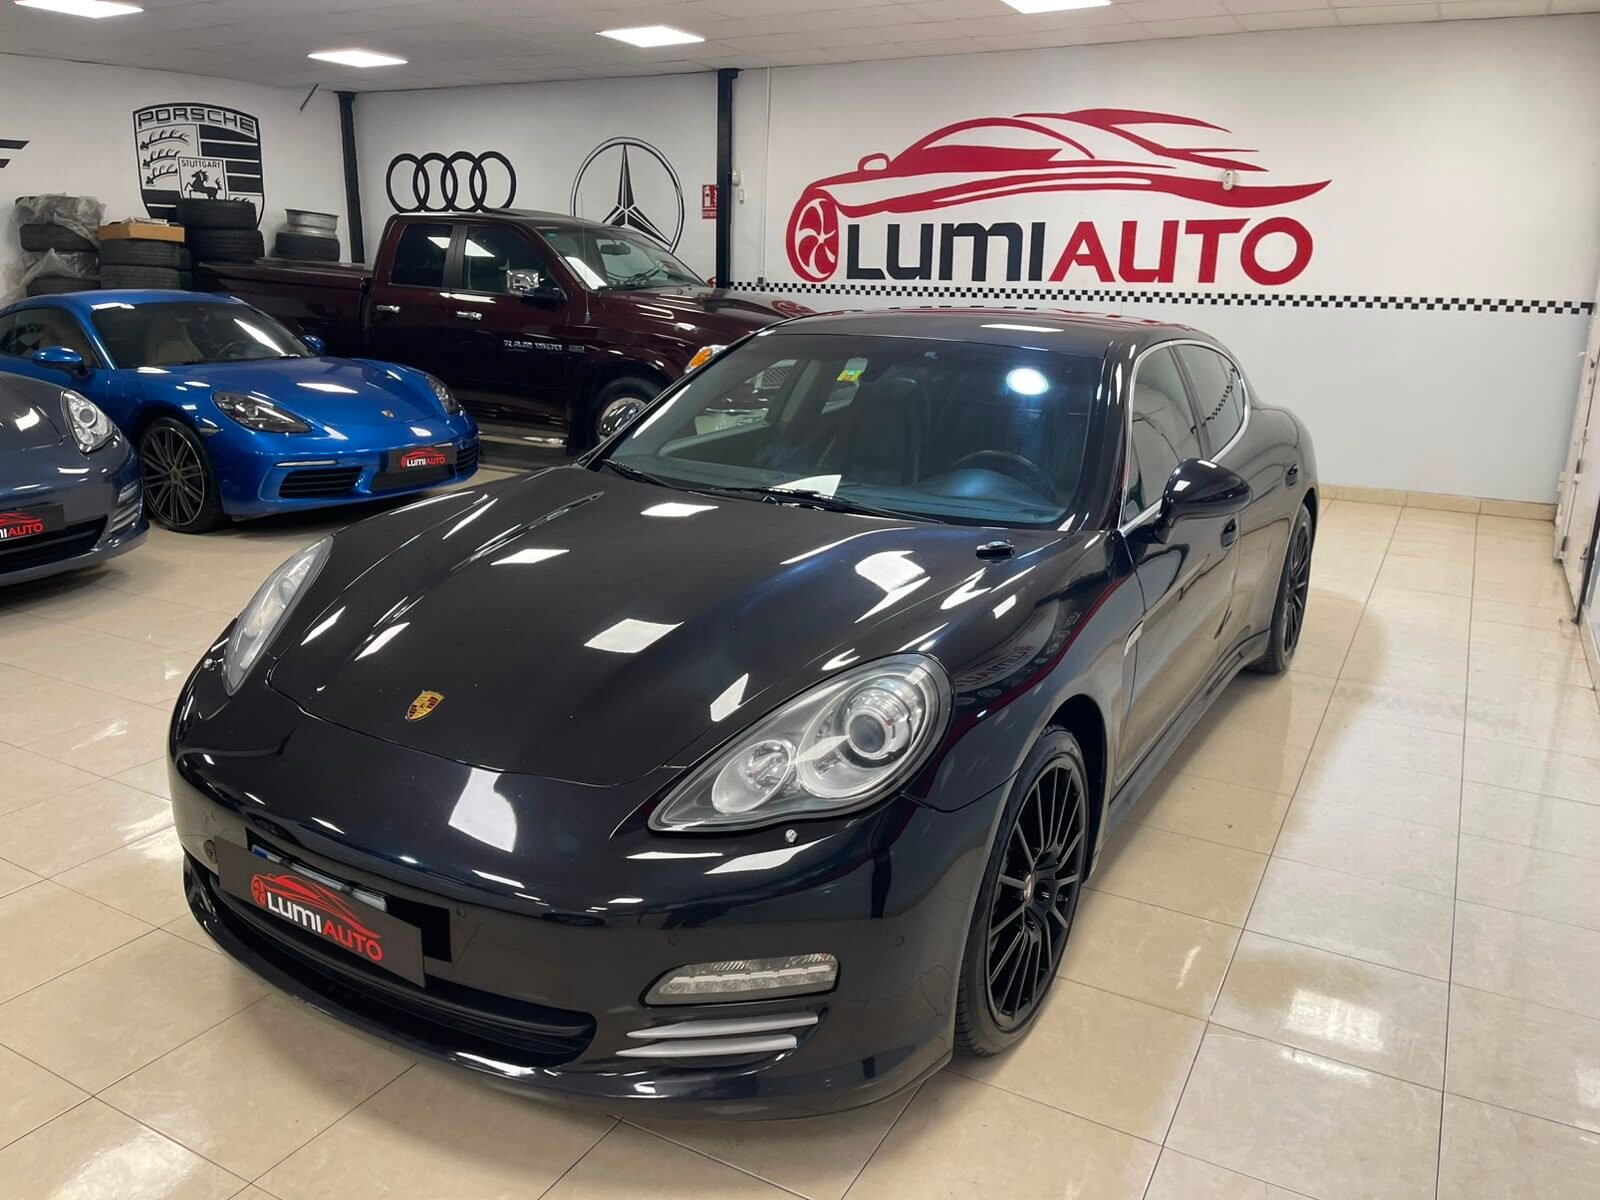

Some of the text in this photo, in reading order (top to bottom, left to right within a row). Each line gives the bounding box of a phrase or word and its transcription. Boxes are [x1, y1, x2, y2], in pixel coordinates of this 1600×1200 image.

[138, 107, 255, 136] PORSCHE
[181, 160, 221, 168] STUTTGART
[846, 216, 1313, 286] LUMIAUTO
[266, 891, 383, 962] LUMIAUTO
